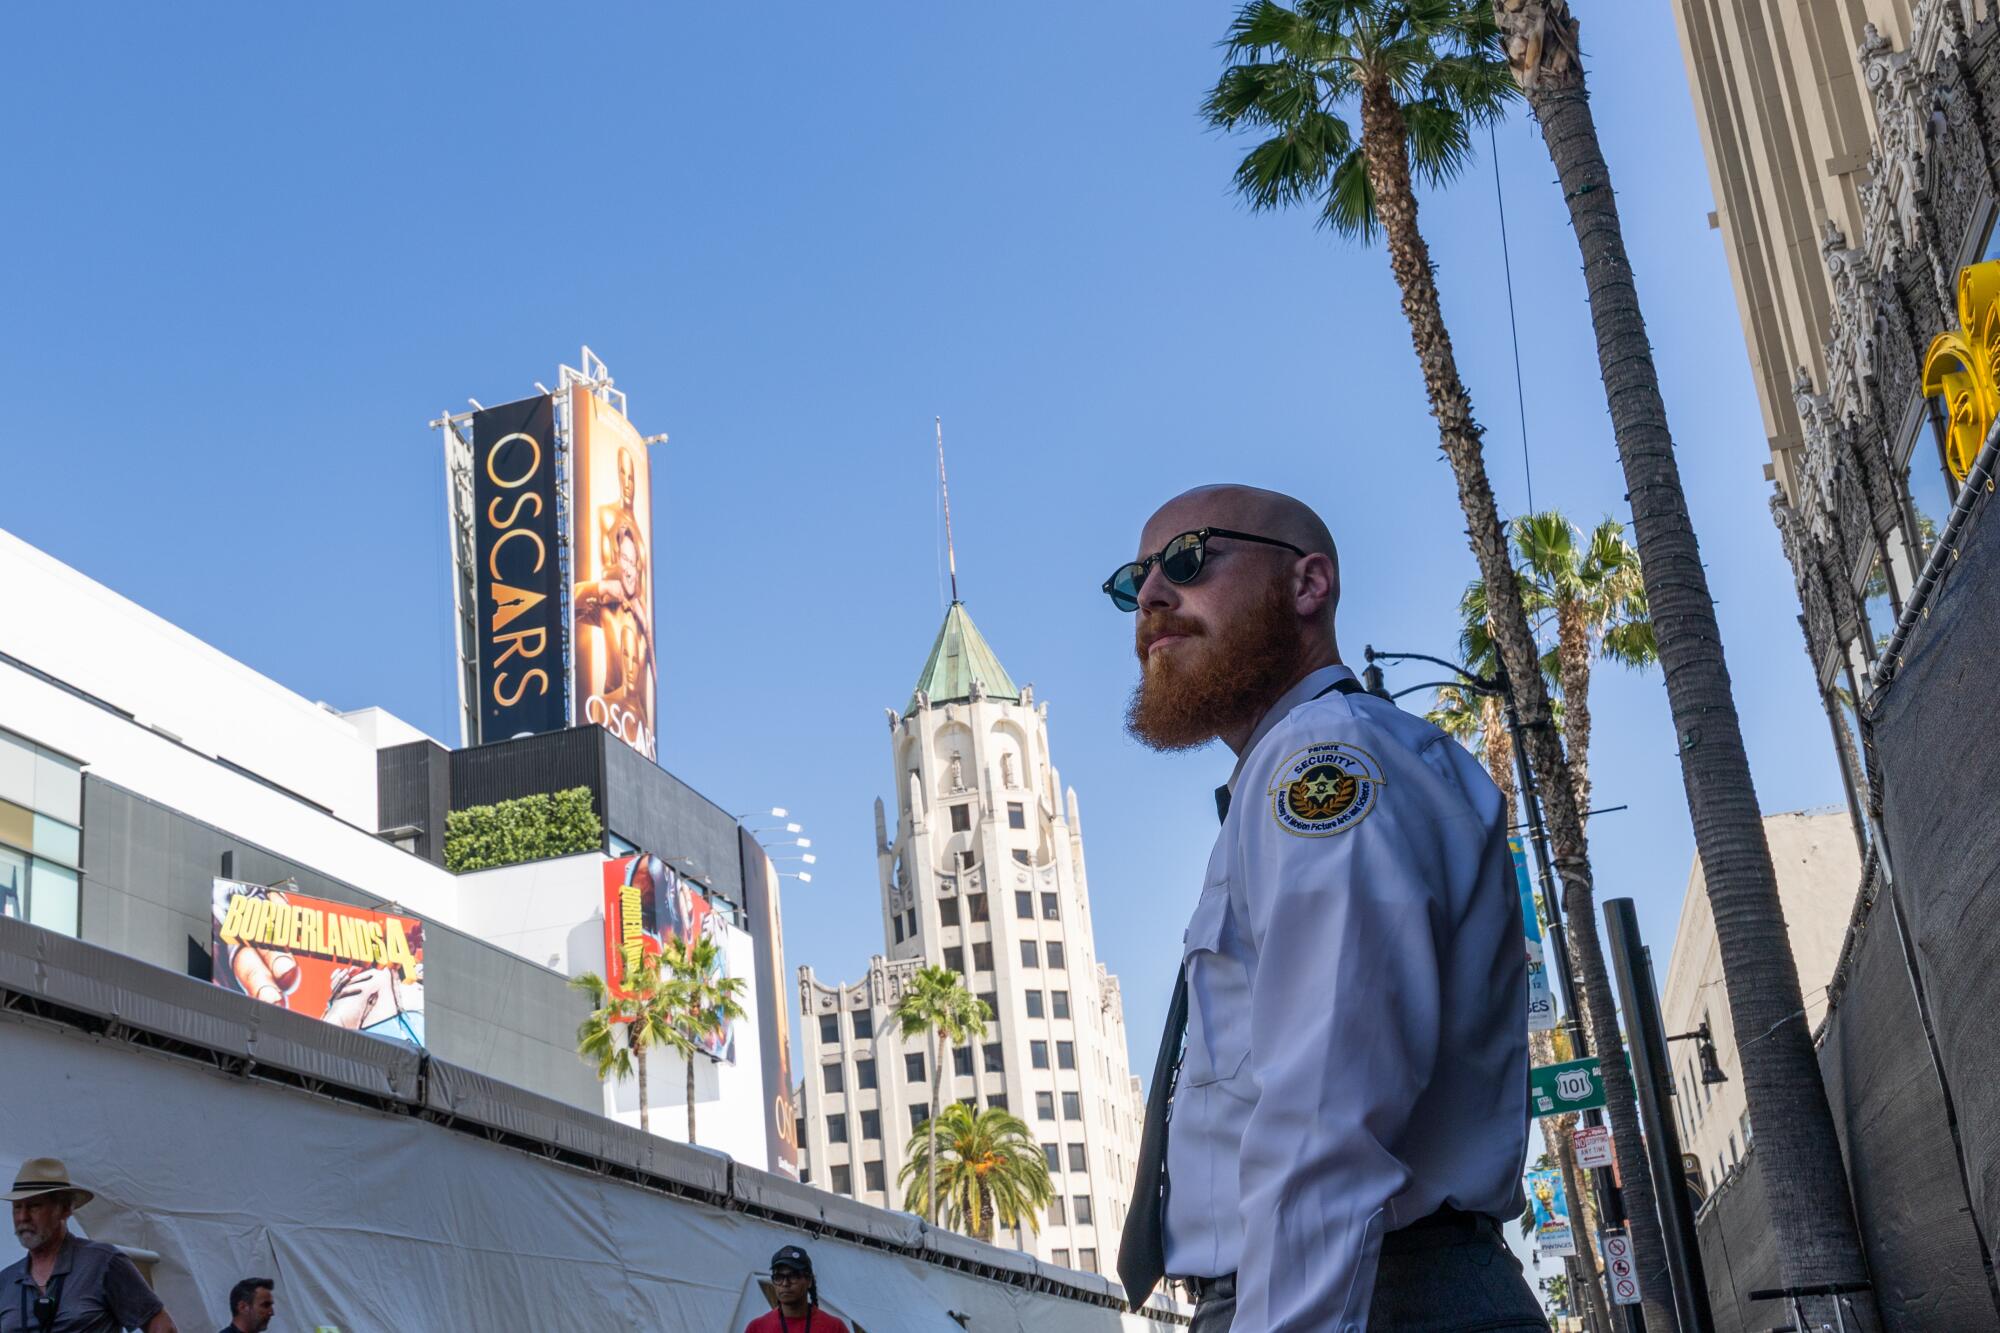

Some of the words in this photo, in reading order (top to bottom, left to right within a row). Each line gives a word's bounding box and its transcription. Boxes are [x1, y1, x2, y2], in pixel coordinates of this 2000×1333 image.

[487, 432, 548, 707] OSCARS
[585, 695, 657, 763] OSCARS
[1308, 745, 1340, 754] PRIVATE
[1294, 754, 1356, 775] SECURITY
[1310, 821, 1337, 831] Picture
[1337, 814, 1352, 825] Arts
[220, 895, 388, 965] BORDERLANDS
[385, 917, 417, 984] 4
[1562, 1078, 1585, 1094] 101
[1575, 1137, 1587, 1149] NO
